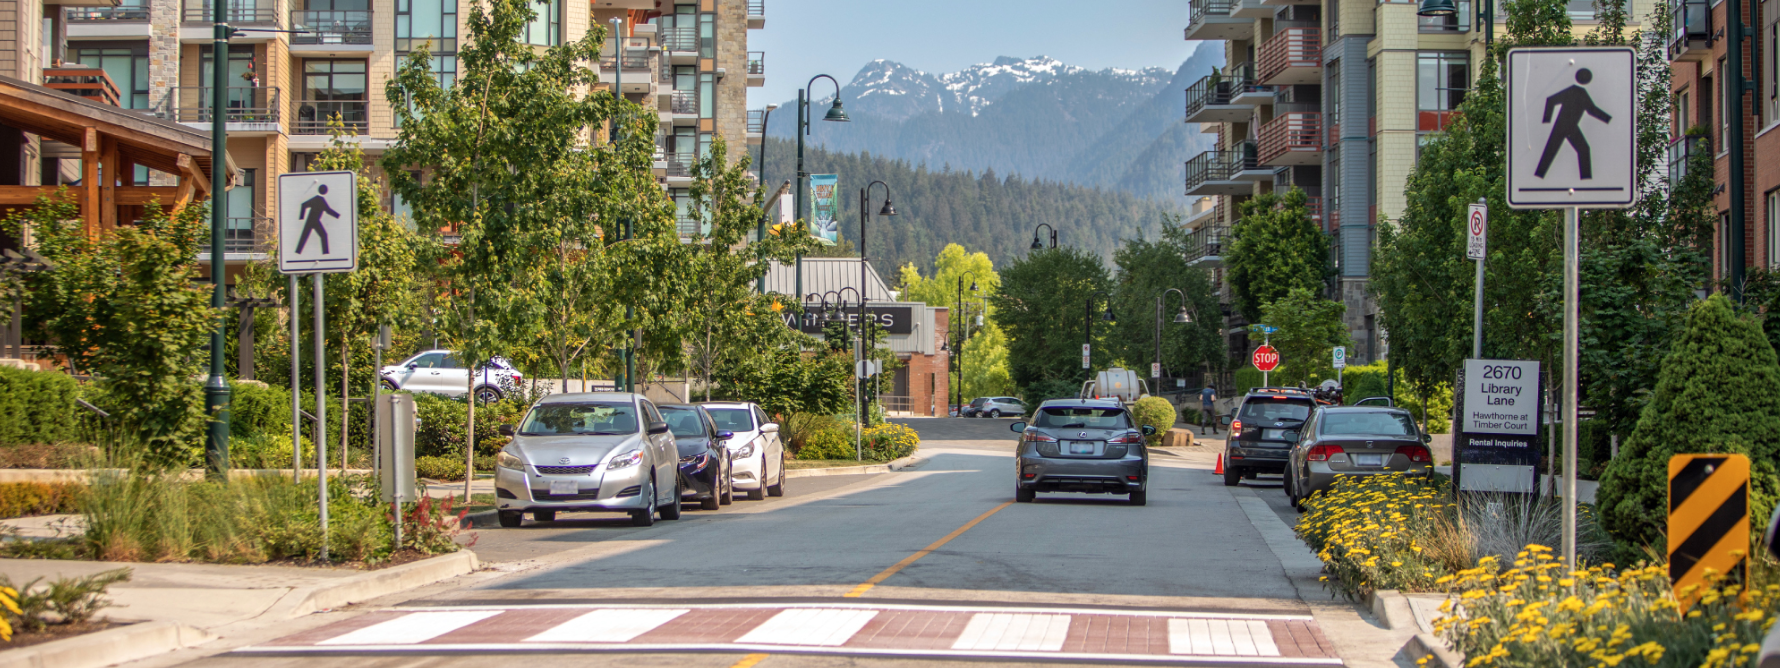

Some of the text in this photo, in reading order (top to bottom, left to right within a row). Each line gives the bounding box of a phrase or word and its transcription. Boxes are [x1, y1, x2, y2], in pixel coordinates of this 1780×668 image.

[780, 313, 894, 327] WINERS
[1255, 353, 1277, 363] STOP
[1483, 365, 1522, 380] 2670
[1481, 383, 1522, 396] Library
[1487, 395, 1515, 406] Lane
[1472, 411, 1528, 421] Hawthorne at
[1473, 420, 1527, 430] Timber Court
[1469, 438, 1527, 448] Rental Inquiries
